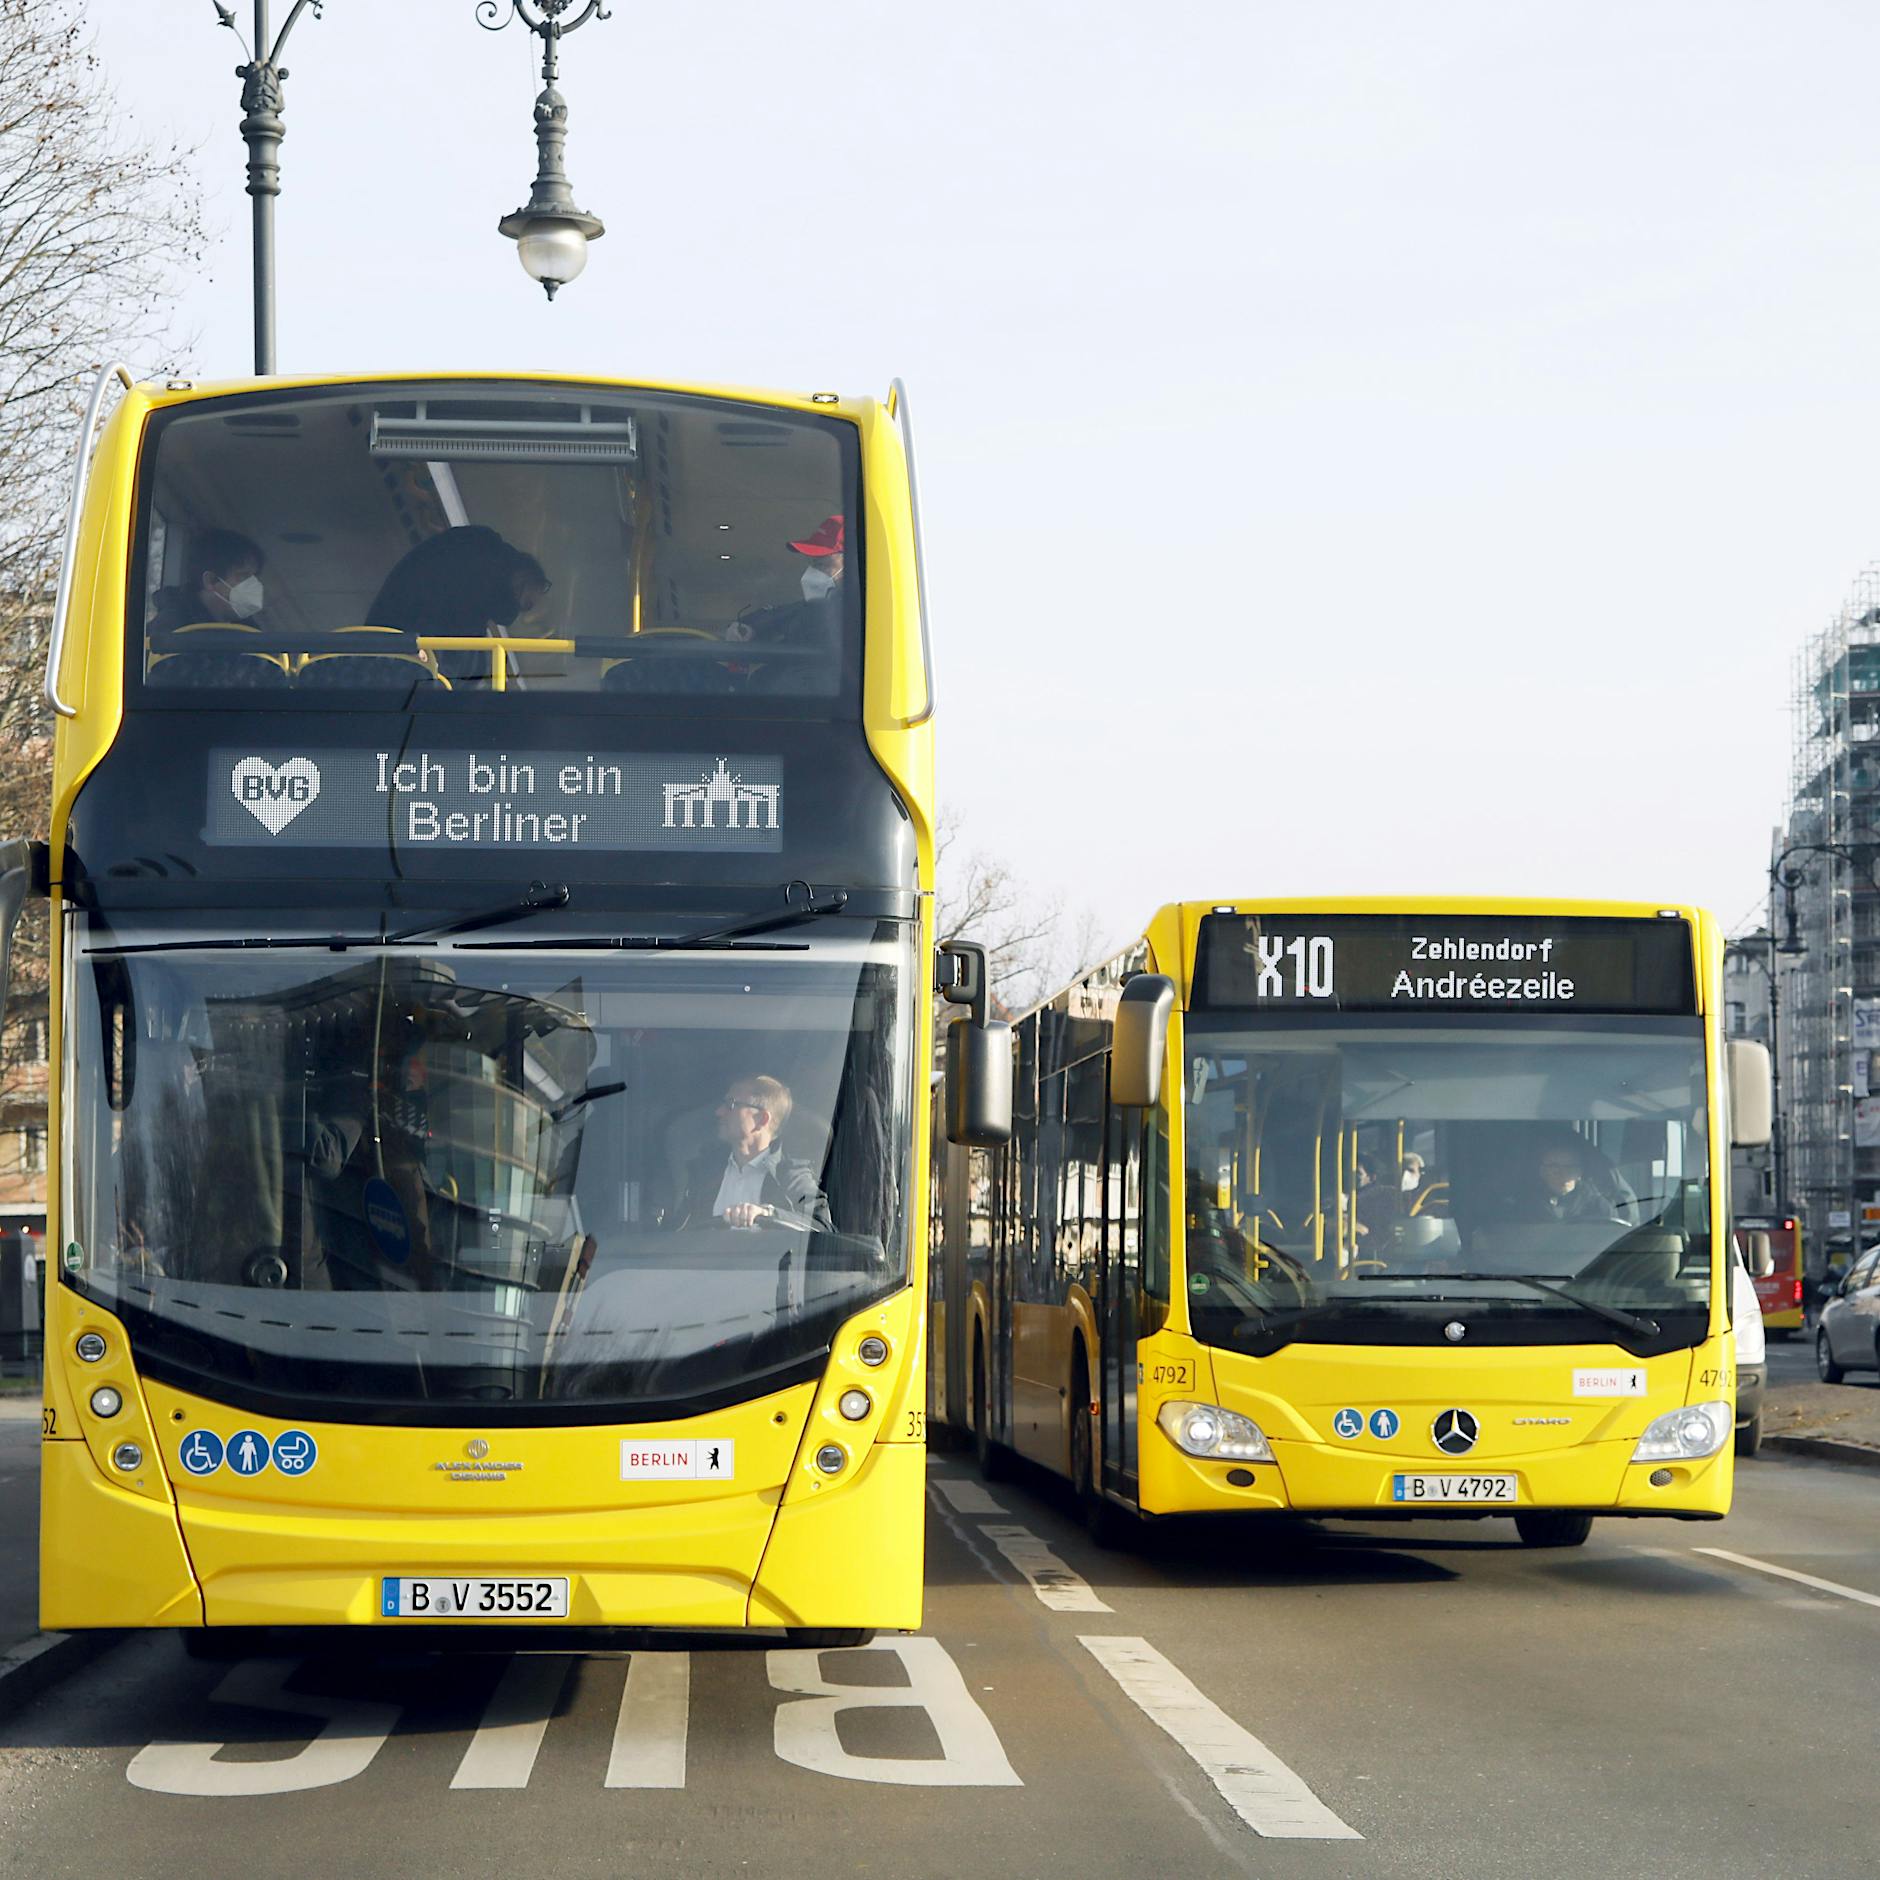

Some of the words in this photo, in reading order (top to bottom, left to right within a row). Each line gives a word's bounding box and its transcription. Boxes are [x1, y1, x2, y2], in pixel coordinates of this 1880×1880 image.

[375, 753, 445, 794] Ich
[469, 754, 535, 794] bin
[558, 756, 622, 795] ein
[243, 775, 309, 801] BVG
[408, 802, 587, 842] Berliner
[1411, 937, 1552, 961] Zehlendorf
[1257, 936, 1335, 998] X10
[1391, 971, 1574, 1000] Andréezeile
[1153, 1366, 1187, 1384] 4792
[1579, 1377, 1617, 1387] BERLIN
[907, 1411, 926, 1437] 35
[631, 1453, 689, 1467] BERLIN
